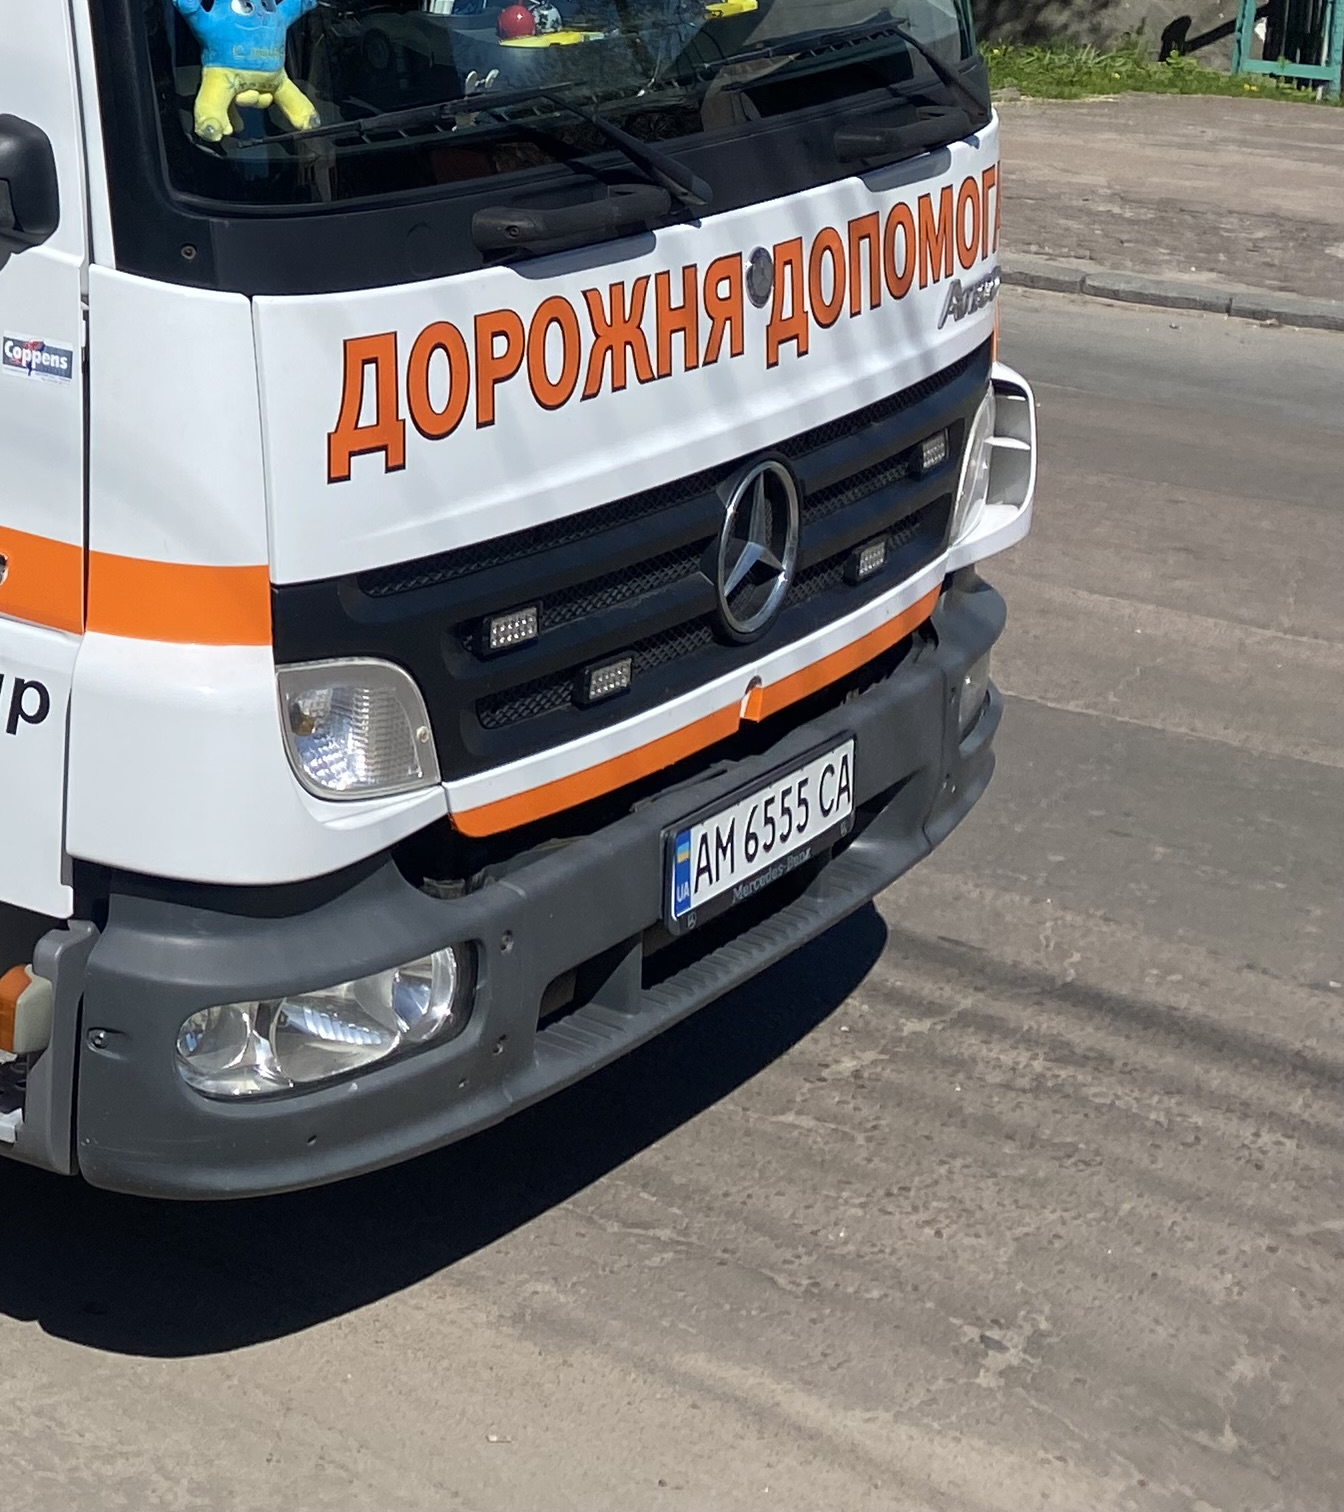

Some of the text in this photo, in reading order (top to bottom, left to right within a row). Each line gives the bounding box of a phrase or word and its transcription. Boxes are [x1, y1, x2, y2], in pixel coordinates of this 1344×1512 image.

[4, 340, 68, 370] Coppens
[327, 250, 746, 485] ДОРОЖНЯ
[693, 753, 852, 894] AM 6555 CA
[676, 880, 690, 903] UA
